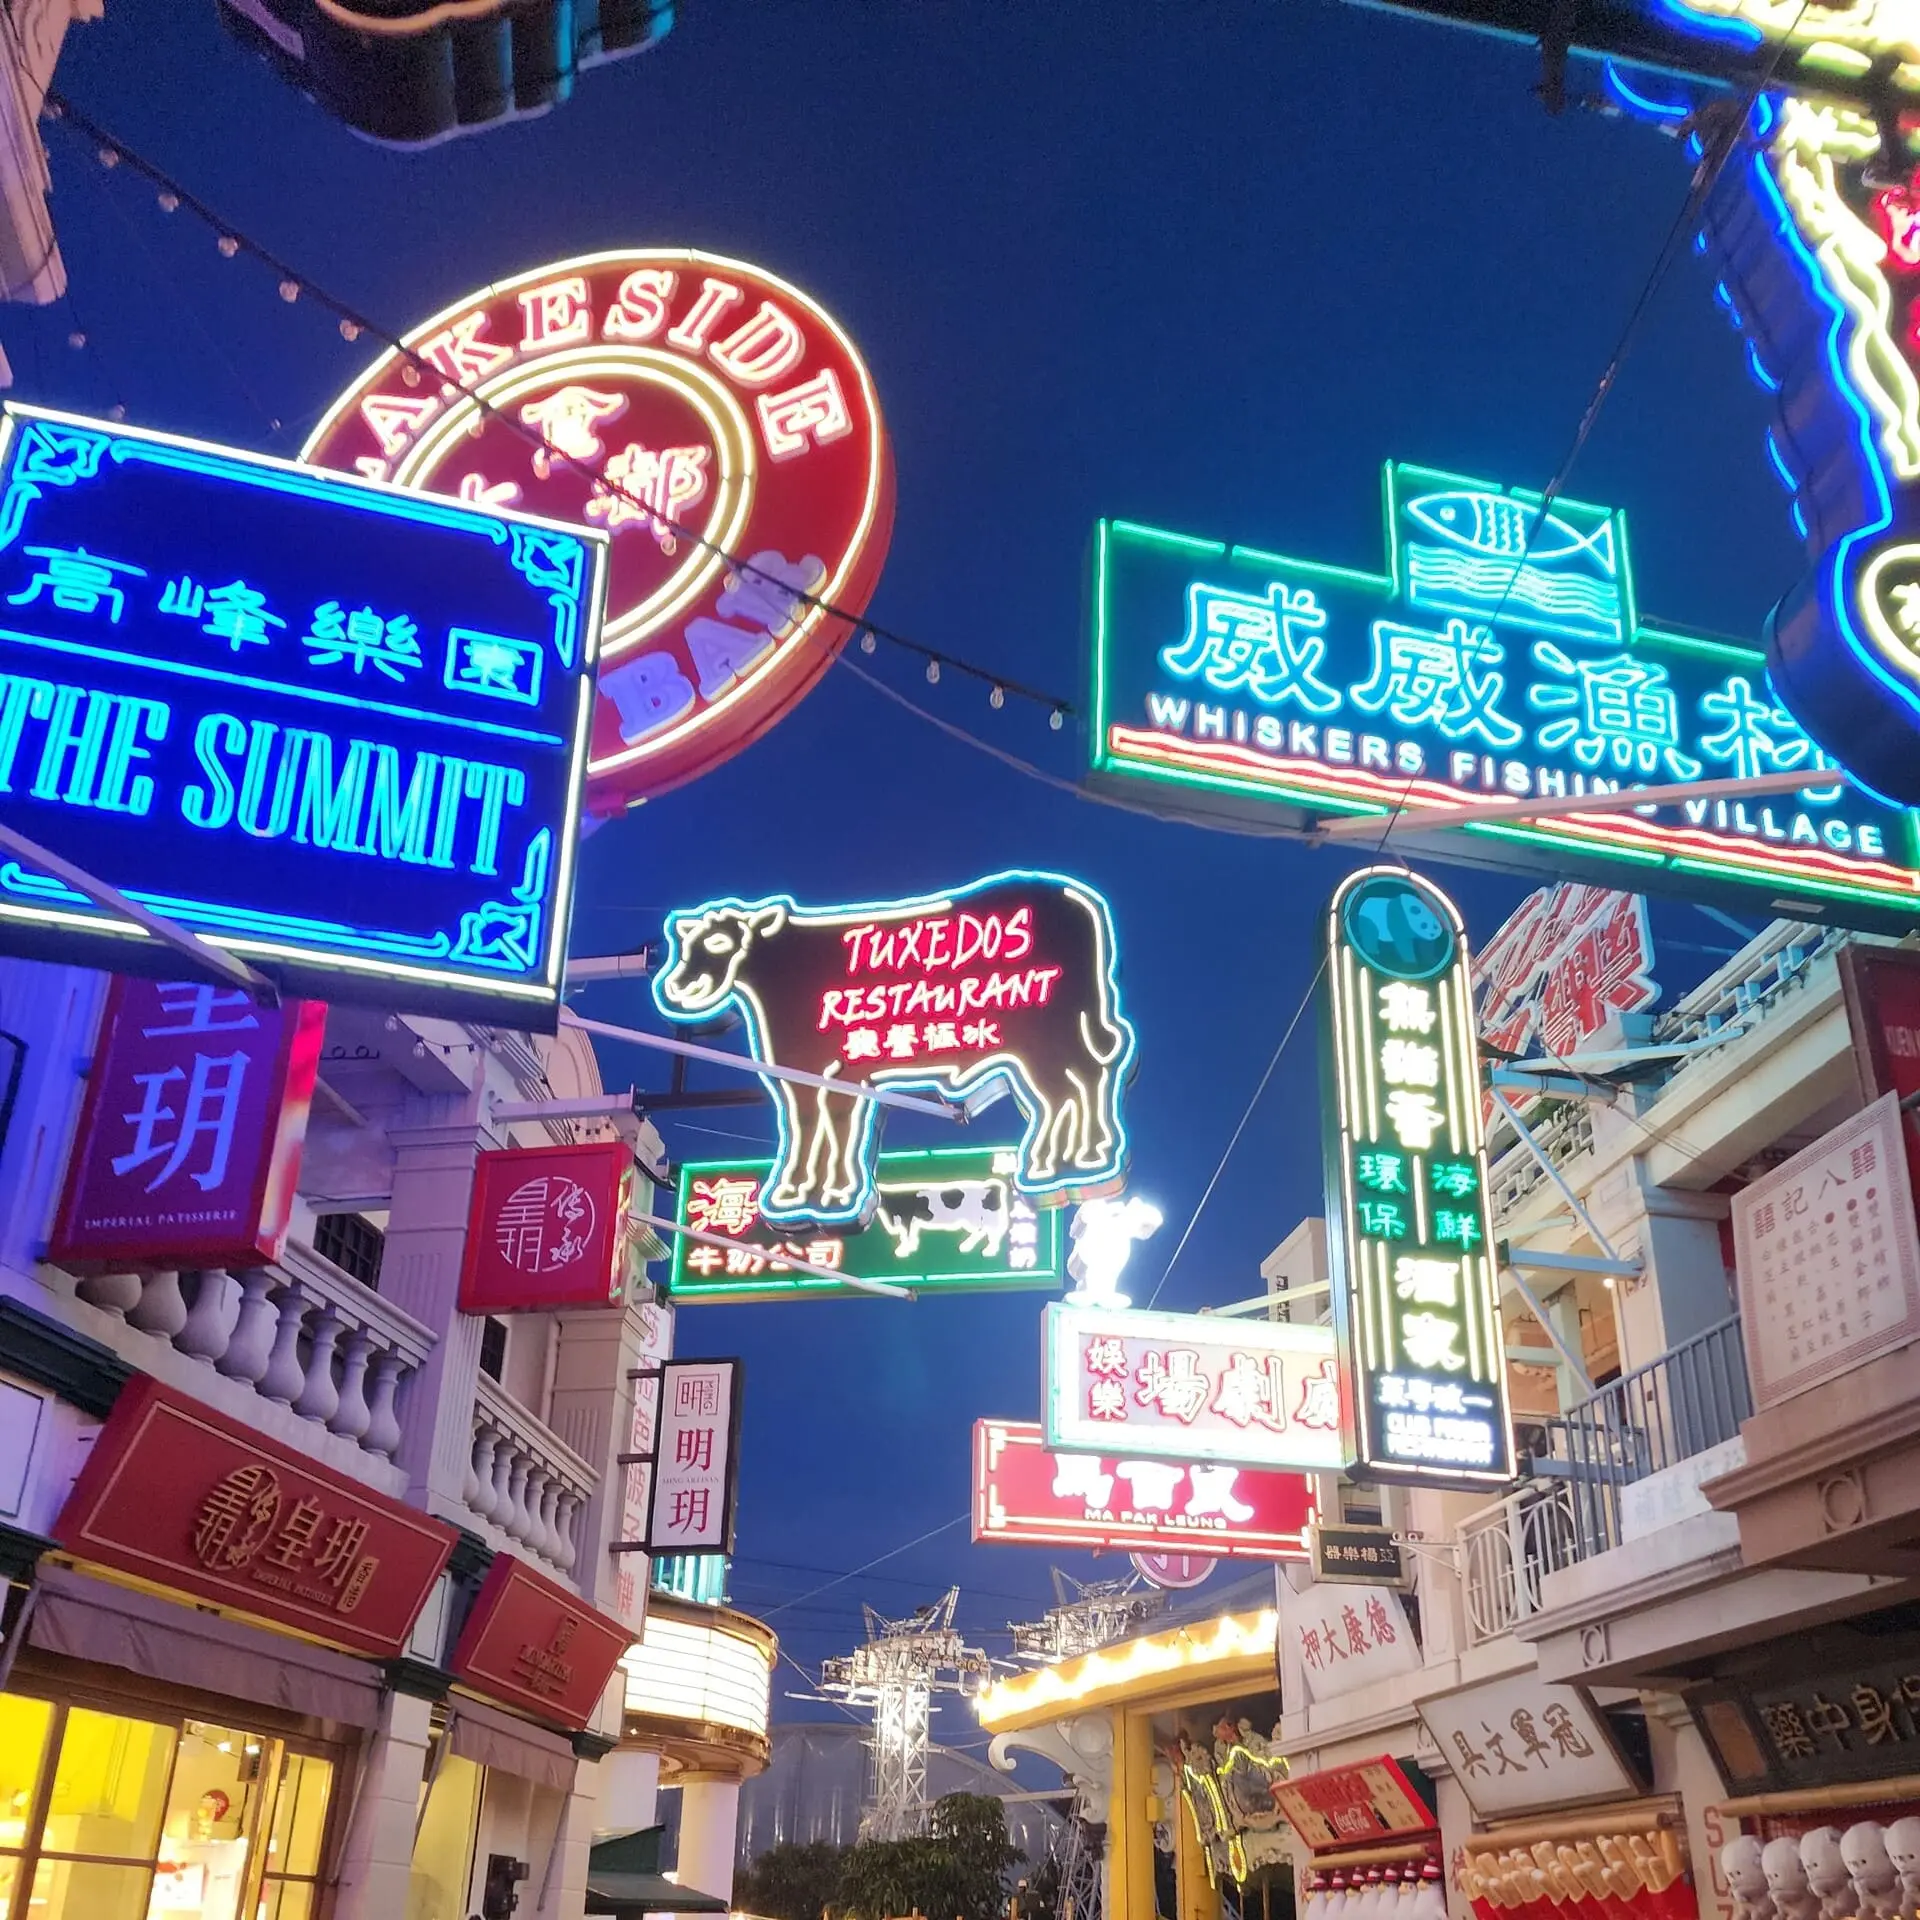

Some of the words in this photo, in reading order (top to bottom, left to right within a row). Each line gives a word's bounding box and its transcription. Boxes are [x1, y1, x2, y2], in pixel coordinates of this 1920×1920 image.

[8, 547, 544, 707] 高峰樂園
[597, 550, 827, 746] BAR
[0, 674, 170, 816] THE
[181, 713, 526, 876] SUMMIT
[1148, 694, 1425, 776] WHISKERS
[1685, 799, 1886, 855] VILLAGE
[843, 907, 1033, 973] TUXEDOS
[819, 967, 1060, 1029] RESTAURANT
[84, 1215, 152, 1230] IMPERIAL
[158, 1209, 238, 1225] PATISSERIE
[1085, 1507, 1114, 1523] MA
[1121, 1509, 1157, 1526] PAK
[1164, 1514, 1227, 1530] LEUNG
